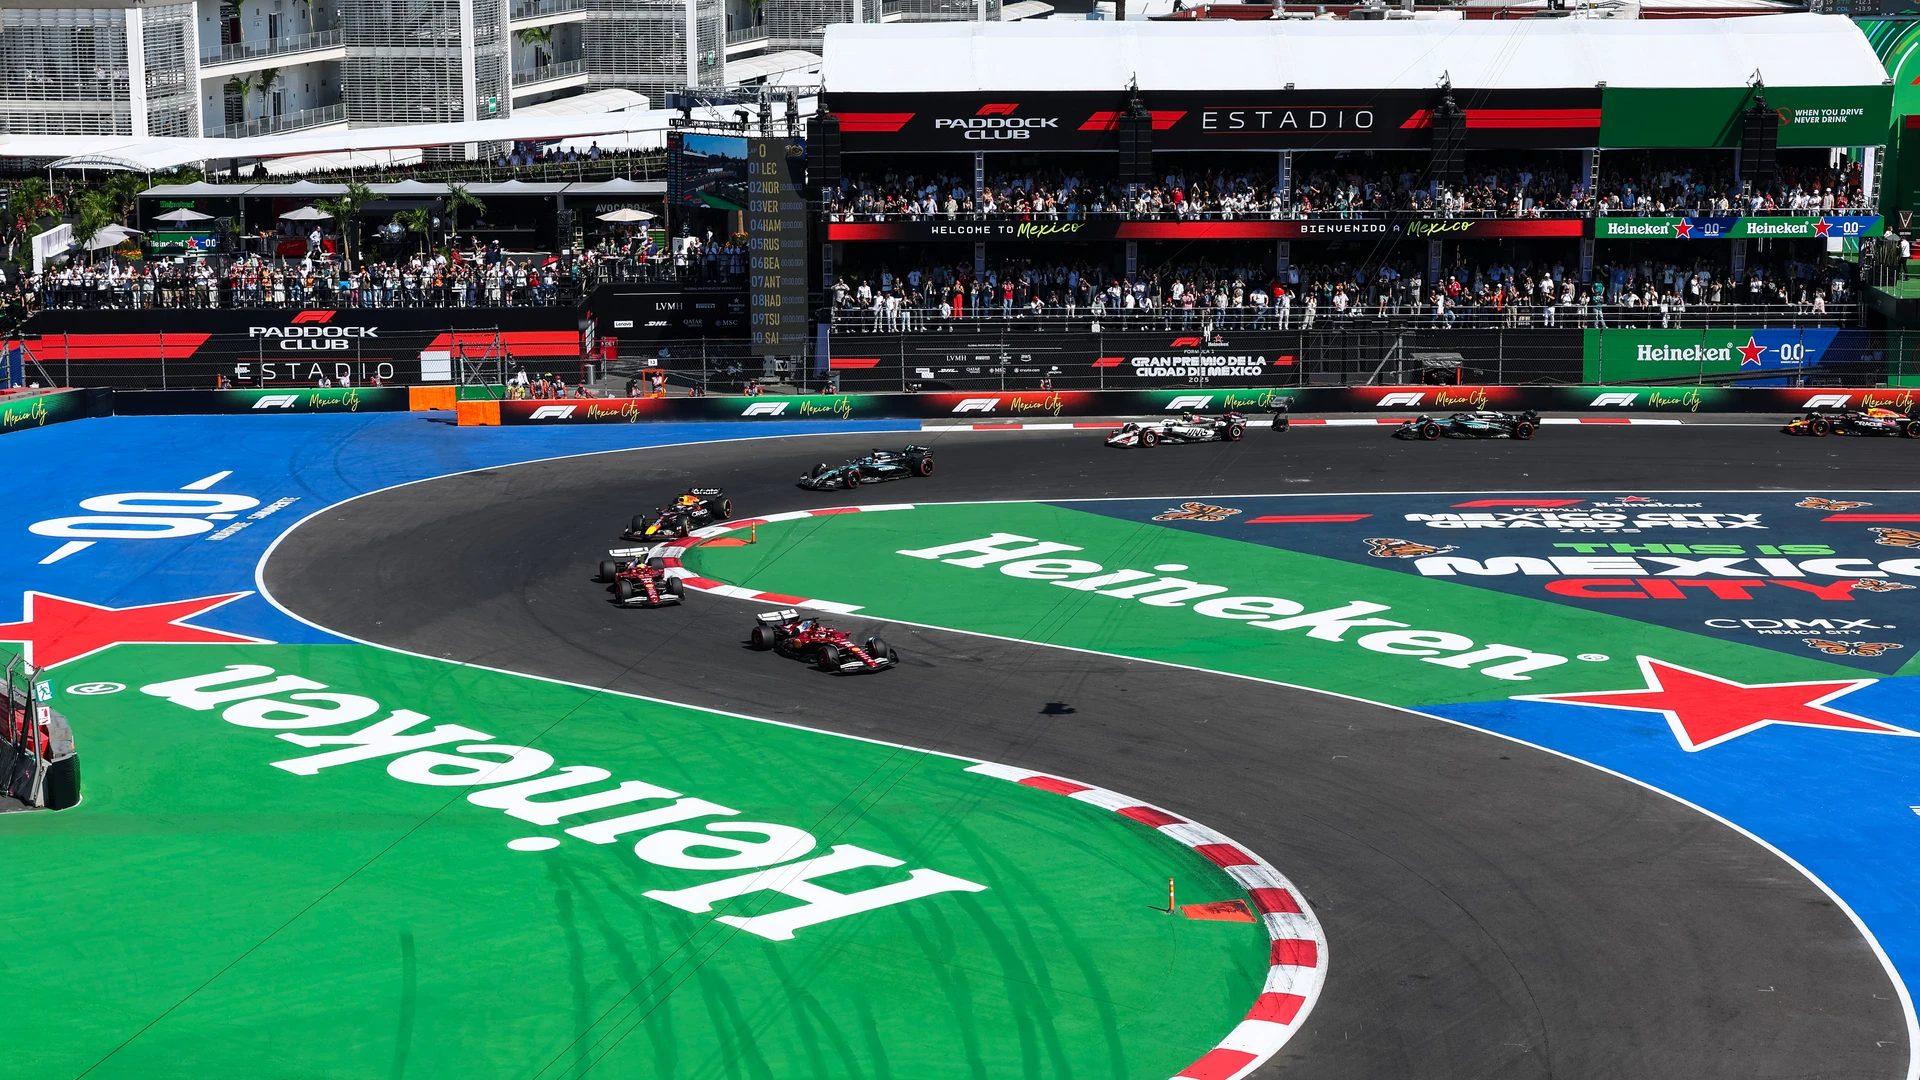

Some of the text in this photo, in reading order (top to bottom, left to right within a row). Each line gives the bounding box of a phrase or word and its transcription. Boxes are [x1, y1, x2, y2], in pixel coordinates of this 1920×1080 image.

[935, 118, 1059, 129] PADDOCK
[1202, 110, 1374, 129] ESTADIO
[1794, 116, 1820, 124] NEVER
[964, 129, 1031, 140] CLUB
[759, 144, 766, 158] 0
[749, 162, 777, 175] 01 LEC
[750, 182, 762, 193] 02
[762, 182, 779, 194] NOR
[750, 200, 762, 212] 03
[762, 200, 778, 212] VER
[750, 219, 763, 230] 04
[763, 220, 781, 231] HAM
[932, 222, 1085, 239] WELCOME TO Mexico
[1300, 221, 1475, 237] BIENVENIDO A Mexico
[1608, 223, 1720, 234] Heineken 0.0
[1747, 222, 1859, 234] Heineken 0.0
[751, 238, 763, 249] 05
[763, 238, 779, 250] RUS
[751, 257, 764, 268] 06
[764, 257, 780, 269] BEA
[752, 276, 764, 287] 07
[764, 276, 780, 288] ANT
[752, 295, 764, 306] 08
[764, 295, 781, 306] HAD
[752, 313, 764, 324] 09
[764, 314, 779, 325] TSU
[250, 327, 378, 338] PADDOCK
[752, 332, 762, 343] 10
[765, 332, 779, 344] SAI
[280, 339, 349, 350] CLUB
[1637, 344, 1731, 361] Heineken
[1131, 356, 1266, 366] GRAN PREMIO DE LA
[237, 363, 394, 379] ESTADIO
[1136, 367, 1186, 377] CIUDAD
[1188, 367, 1206, 376] DE
[310, 389, 360, 412] Mexico City
[1011, 393, 1063, 416] Mexico City
[1224, 389, 1275, 409] Mexico Cit
[1436, 388, 1488, 410] Mexico City
[1648, 388, 1702, 412] Mexico City
[1861, 390, 1915, 413] Mexico City
[4, 398, 48, 426] Mexico City
[588, 400, 640, 423] Mexico City
[800, 396, 852, 419] Mexico City
[1404, 513, 1762, 521] MEXICO CITY
[1425, 520, 1769, 529] GRAND PRIX
[1552, 543, 1836, 555] THIS IS
[1544, 578, 1857, 600] CITY
[896, 532, 1570, 682] Heineken
[1705, 618, 1881, 630] CDMX
[140, 664, 988, 942] Heineken
